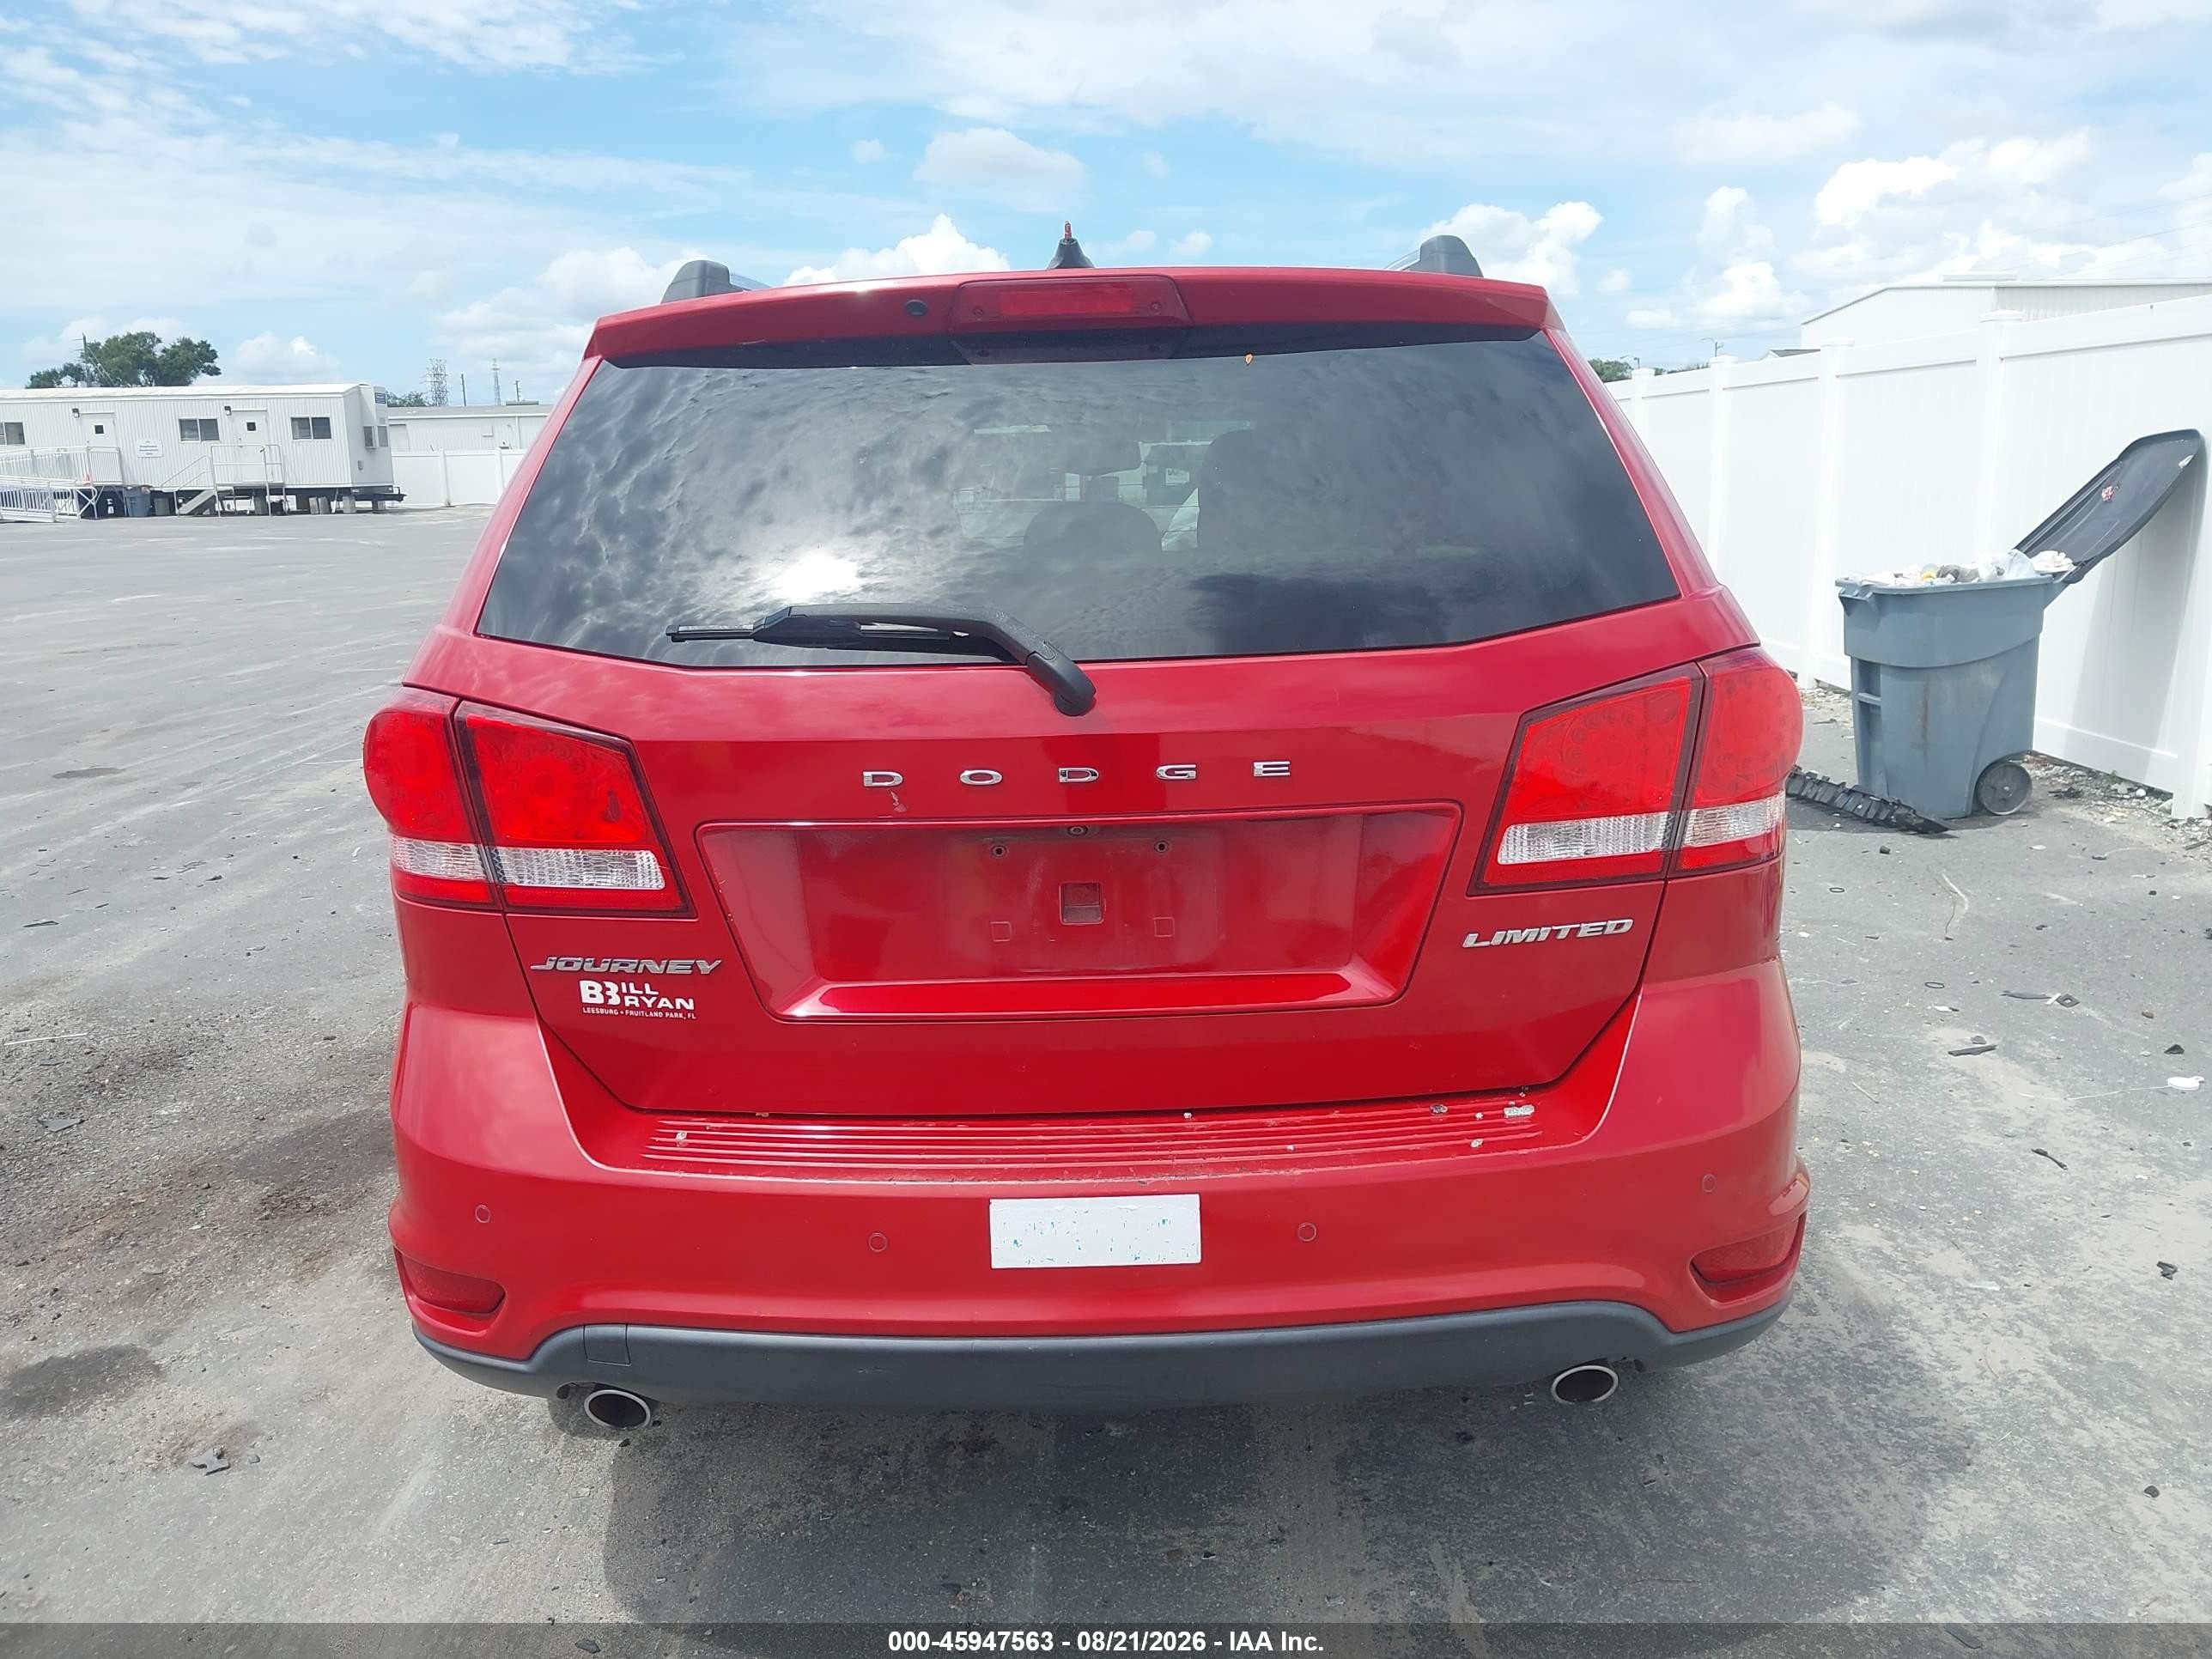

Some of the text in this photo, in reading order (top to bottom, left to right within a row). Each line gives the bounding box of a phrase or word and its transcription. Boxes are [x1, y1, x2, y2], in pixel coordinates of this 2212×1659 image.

[862, 760, 1291, 787] DODGE
[1462, 919, 1634, 948] LIMITED
[530, 957, 722, 975] JOURNEY
[582, 1006, 619, 1016] LEESBURG
[625, 1009, 664, 1018] FRUITLAND
[665, 1012, 687, 1020] PARK,
